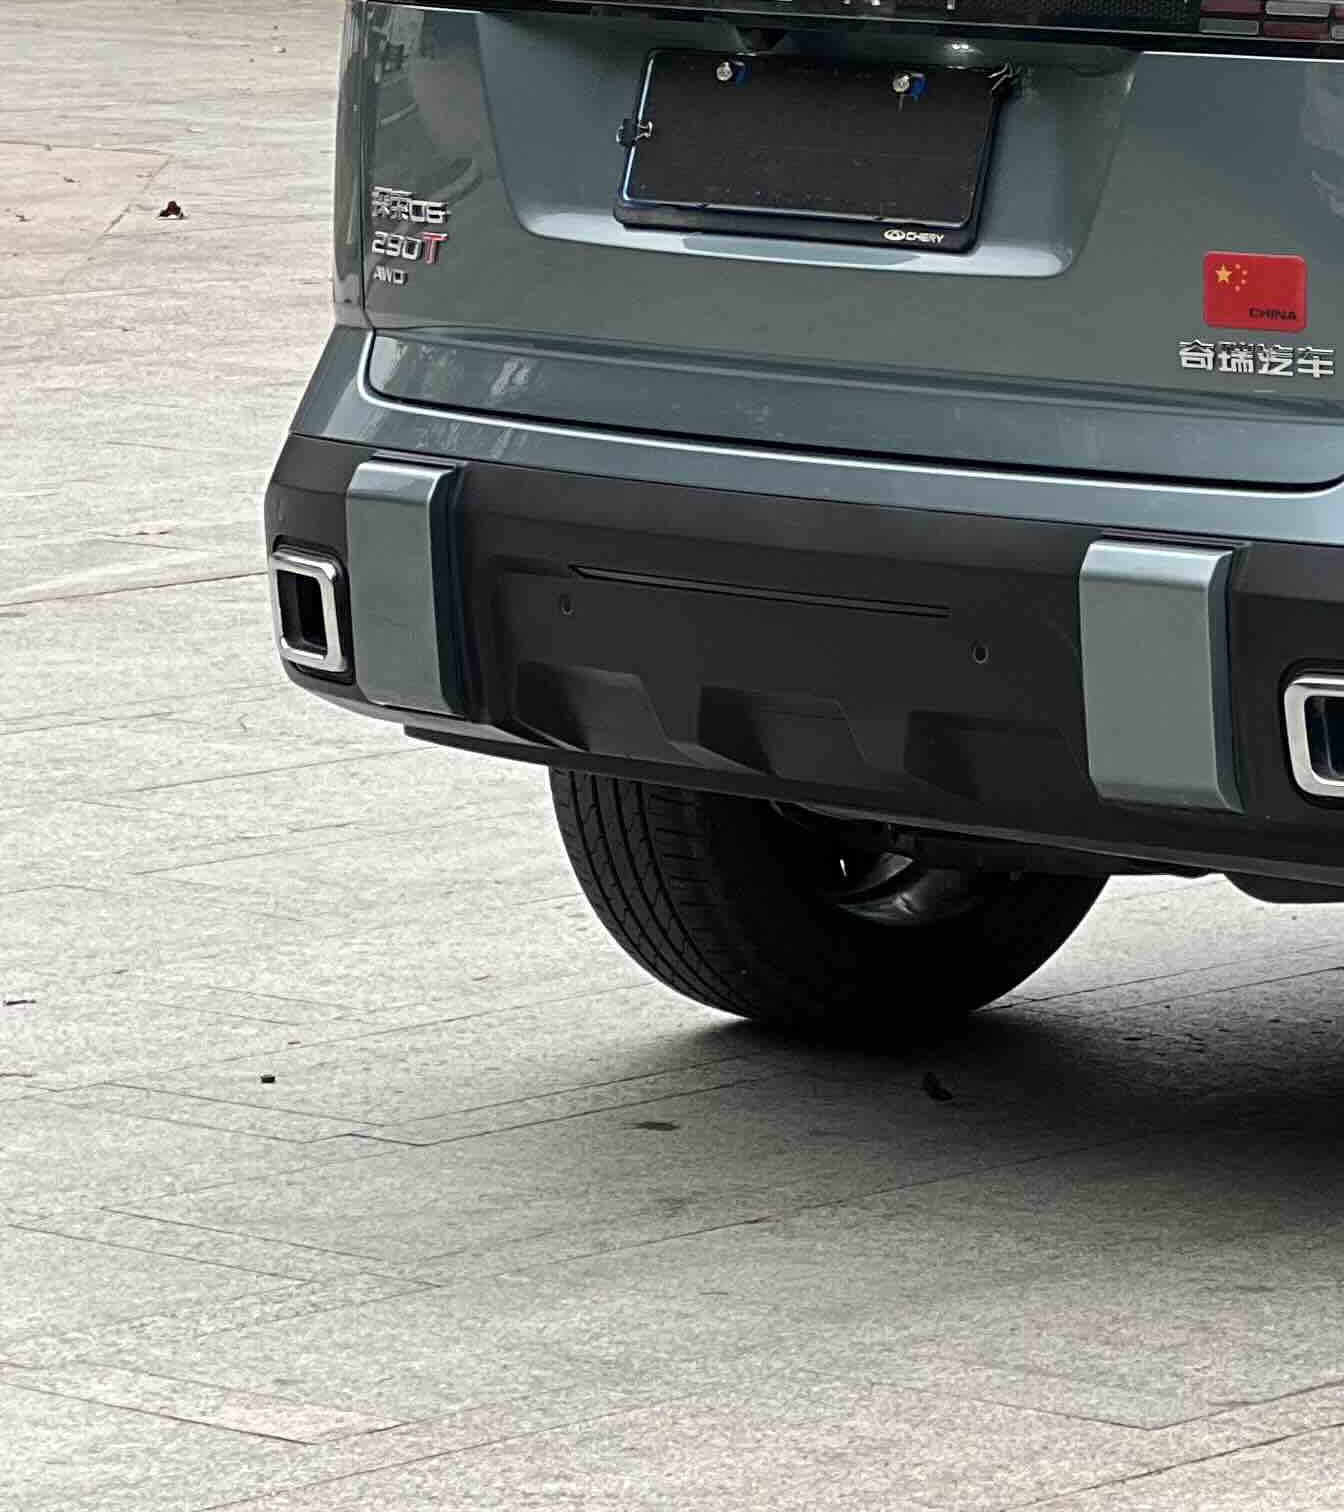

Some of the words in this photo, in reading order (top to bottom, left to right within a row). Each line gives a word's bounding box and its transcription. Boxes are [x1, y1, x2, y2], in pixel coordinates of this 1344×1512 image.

[372, 230, 449, 264] 290T
[905, 231, 945, 244] CHERY
[373, 265, 408, 285] AWD
[1249, 307, 1297, 321] CHINA
[1178, 338, 1335, 379] 奇瑞汽车
